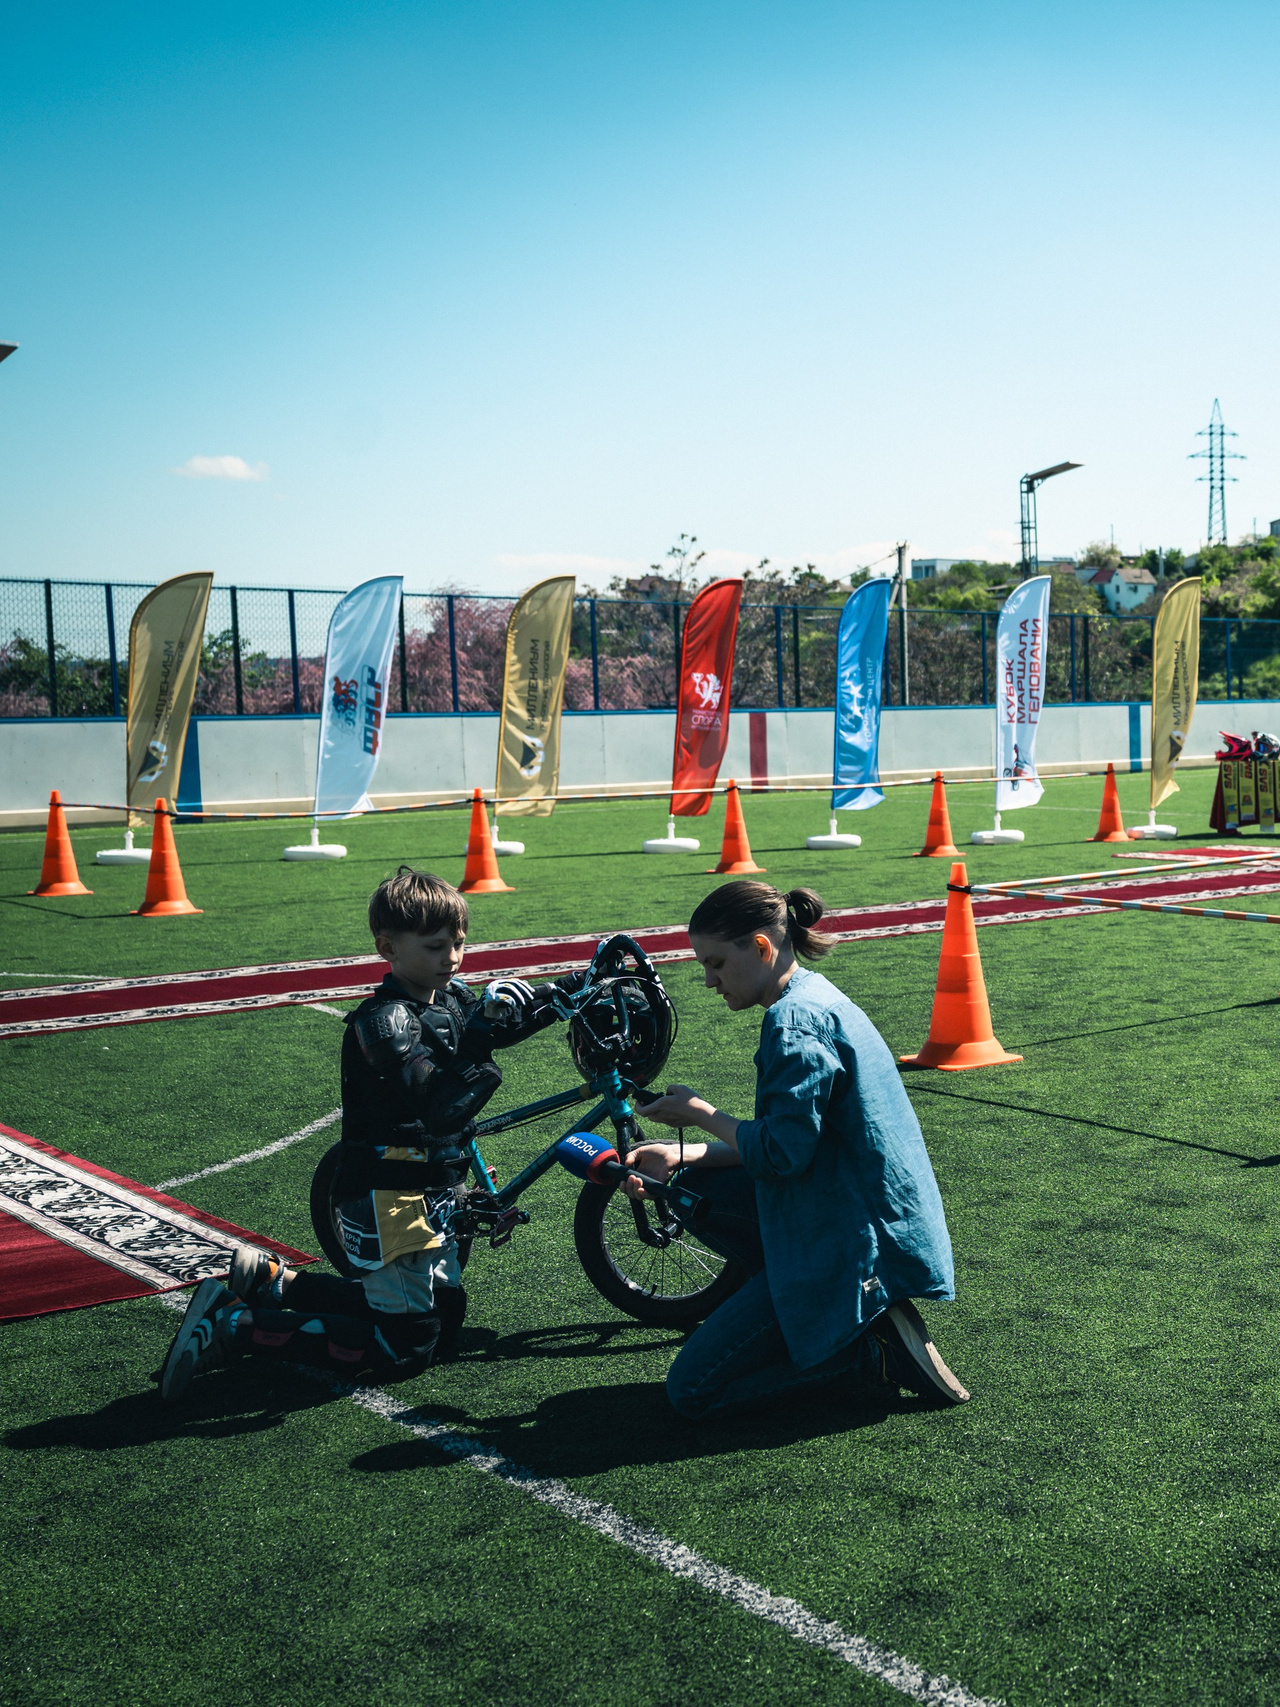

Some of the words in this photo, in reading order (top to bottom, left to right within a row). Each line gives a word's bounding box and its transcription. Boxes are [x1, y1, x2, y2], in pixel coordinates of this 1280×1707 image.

[525, 638, 540, 731] МИЛЛЕНИУМ
[1005, 658, 1016, 724] КУБОК
[1016, 618, 1029, 724] МАРШАЛА
[1028, 618, 1041, 725] ГЕЛОВАНИ
[565, 1135, 599, 1157] РОССИЯ
